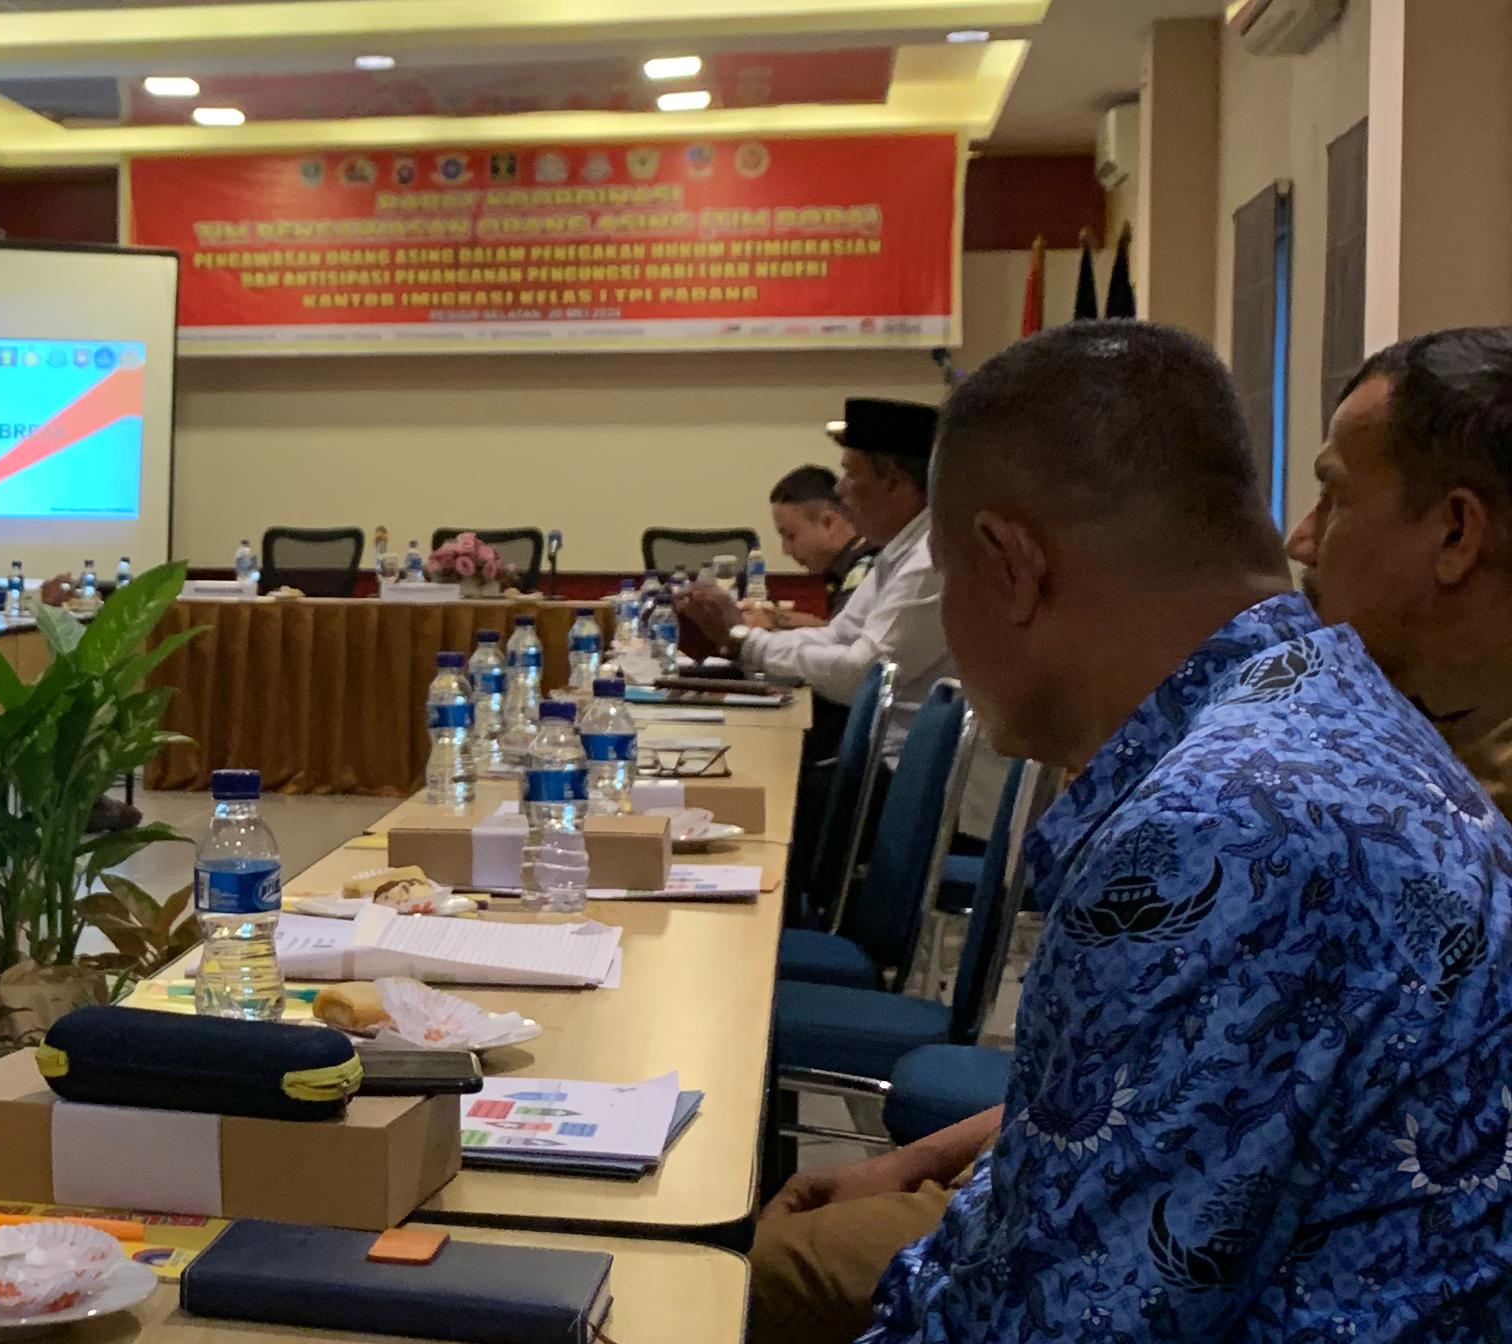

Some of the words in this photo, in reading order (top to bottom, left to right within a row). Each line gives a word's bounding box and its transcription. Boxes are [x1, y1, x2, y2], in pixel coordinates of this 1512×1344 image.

[194, 251, 320, 268] PENGAWASAN
[325, 249, 390, 265] ORANG
[395, 248, 454, 264] ASING
[459, 246, 525, 263] DALAM
[530, 242, 645, 262] PENEGAKAN
[651, 241, 725, 258] HUKUM
[241, 272, 279, 288] DAN
[283, 270, 390, 287] ANTISIPASI
[395, 267, 522, 285] PENANGANAN
[527, 264, 639, 283] PENGUNGSI
[755, 259, 828, 277] NEGERI
[302, 292, 394, 308] KANTOR
[401, 290, 514, 306] IMIGRASI
[519, 288, 592, 305] KELAS
[659, 285, 758, 302] PADANG
